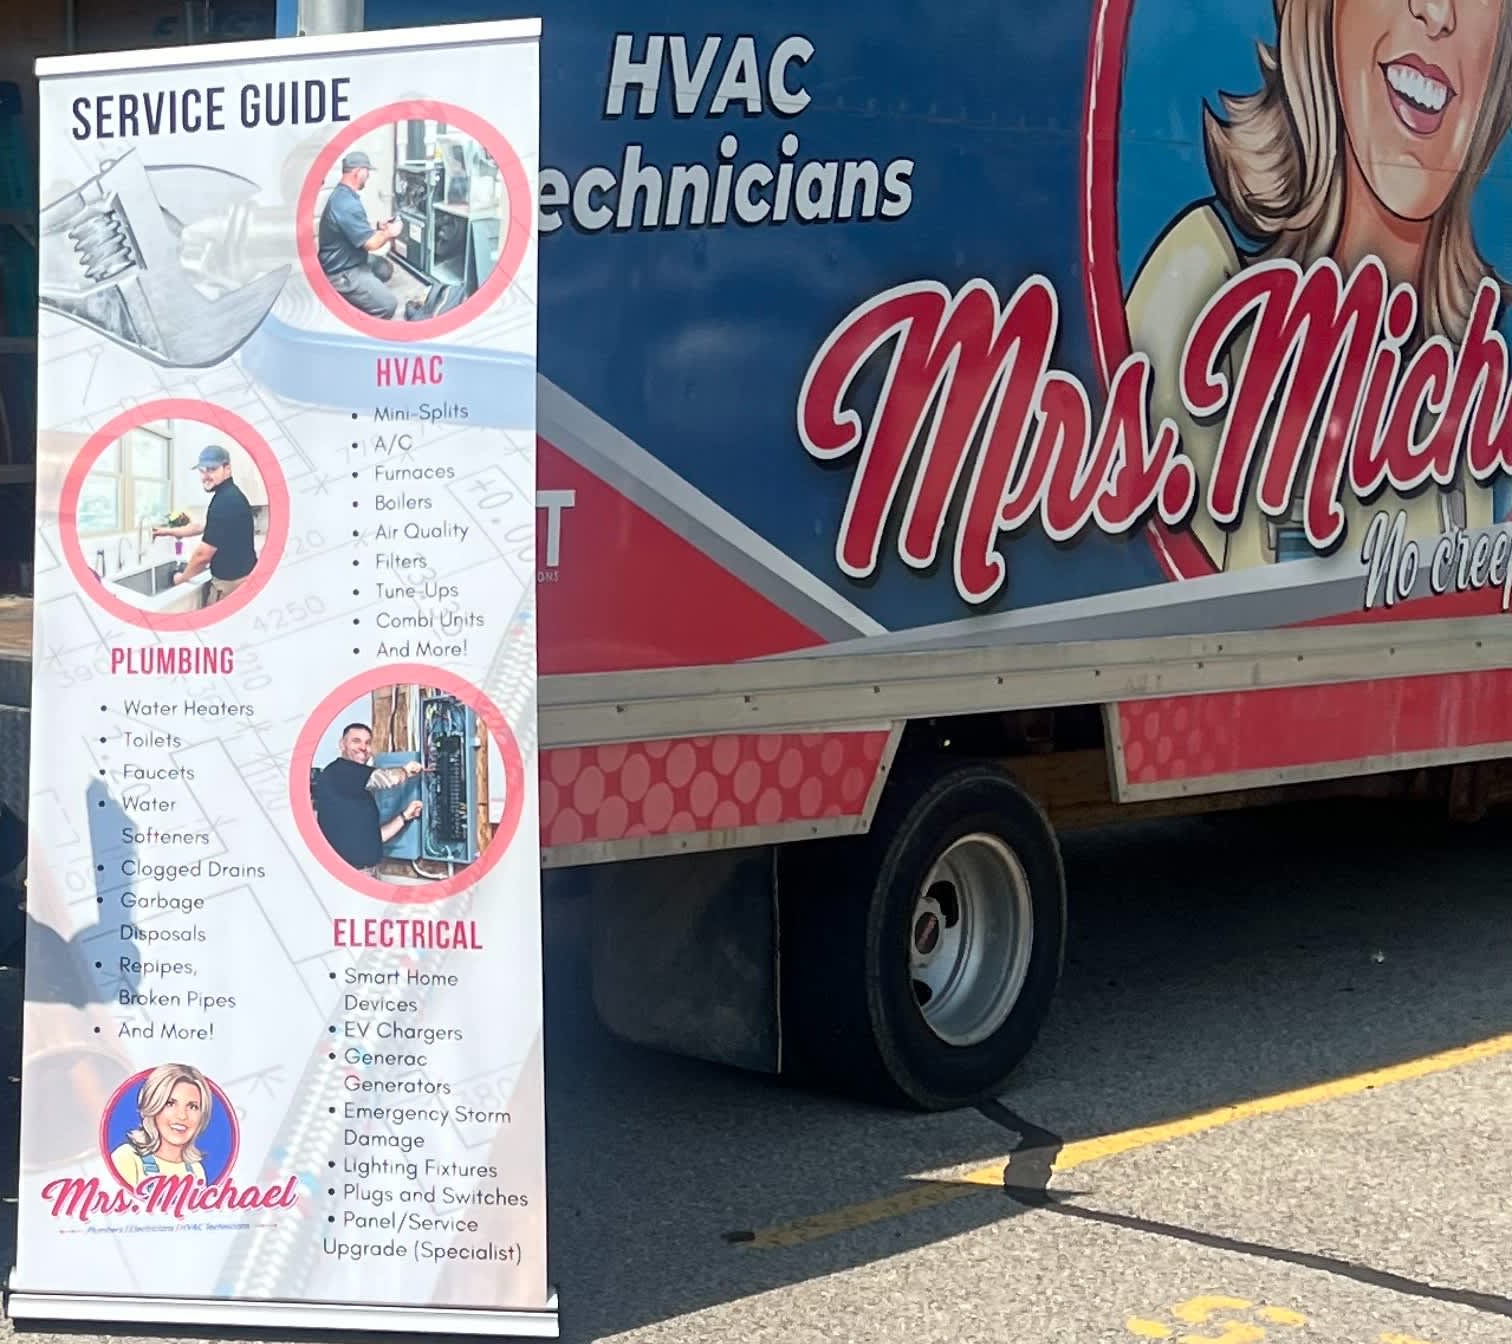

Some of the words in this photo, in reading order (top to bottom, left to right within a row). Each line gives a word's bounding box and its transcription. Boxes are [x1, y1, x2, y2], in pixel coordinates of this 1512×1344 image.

[604, 34, 816, 116] HVAC
[72, 87, 225, 140] SERVICE
[240, 77, 351, 128] GUIDE
[540, 134, 916, 232] echnicians
[376, 355, 444, 387] HVAC
[373, 404, 469, 425] Mini-Splits
[797, 274, 1195, 605] Mrs.
[1180, 253, 1512, 550] Mich
[374, 433, 413, 456] A/C
[374, 465, 456, 482] Furnaces
[375, 494, 433, 511] Boilers
[375, 523, 399, 540] Air
[403, 522, 469, 543] Quality
[375, 552, 428, 570] Filters
[1361, 509, 1420, 609] No
[376, 582, 459, 602] Tune-Ups
[376, 611, 433, 629] Combi
[439, 611, 485, 629] Units
[376, 641, 410, 658] And
[415, 640, 468, 658] More!
[112, 646, 234, 675] PLUMBING
[123, 699, 178, 716] Water
[184, 699, 255, 717] Heaters
[123, 730, 182, 748] Toilets
[123, 763, 195, 781] Faucets
[121, 795, 176, 813] Water
[121, 826, 210, 845] Softeners
[121, 859, 202, 881] Clogged
[208, 860, 266, 879] Drains
[120, 891, 205, 914] Garbage
[119, 924, 207, 945] Disposals
[333, 918, 483, 950] ELECTRICAL
[119, 956, 198, 979] Repipes,
[344, 967, 400, 986] Smart
[407, 968, 459, 987] Home
[118, 988, 181, 1007] Broken
[187, 990, 237, 1013] Pipes
[344, 994, 418, 1013] Devices
[117, 1022, 154, 1039] And
[160, 1023, 214, 1040] More!
[344, 1020, 372, 1038] EV
[376, 1020, 464, 1045] Chargers
[344, 1047, 428, 1067] Generac
[344, 1074, 452, 1095] Generators
[344, 1101, 450, 1127] Emergency
[455, 1105, 512, 1124] Storm
[344, 1129, 425, 1153] Damage
[344, 1156, 418, 1180] Lighting
[425, 1158, 498, 1178] Fixtures
[41, 1177, 139, 1222] Mrs.
[136, 1174, 298, 1220] Michael
[343, 1183, 393, 1206] Plugs
[399, 1186, 435, 1203] and
[442, 1187, 529, 1207] Switches
[343, 1211, 479, 1233] Panel/Service
[322, 1238, 408, 1261] Upgrade
[414, 1239, 522, 1266] (Specialist)
